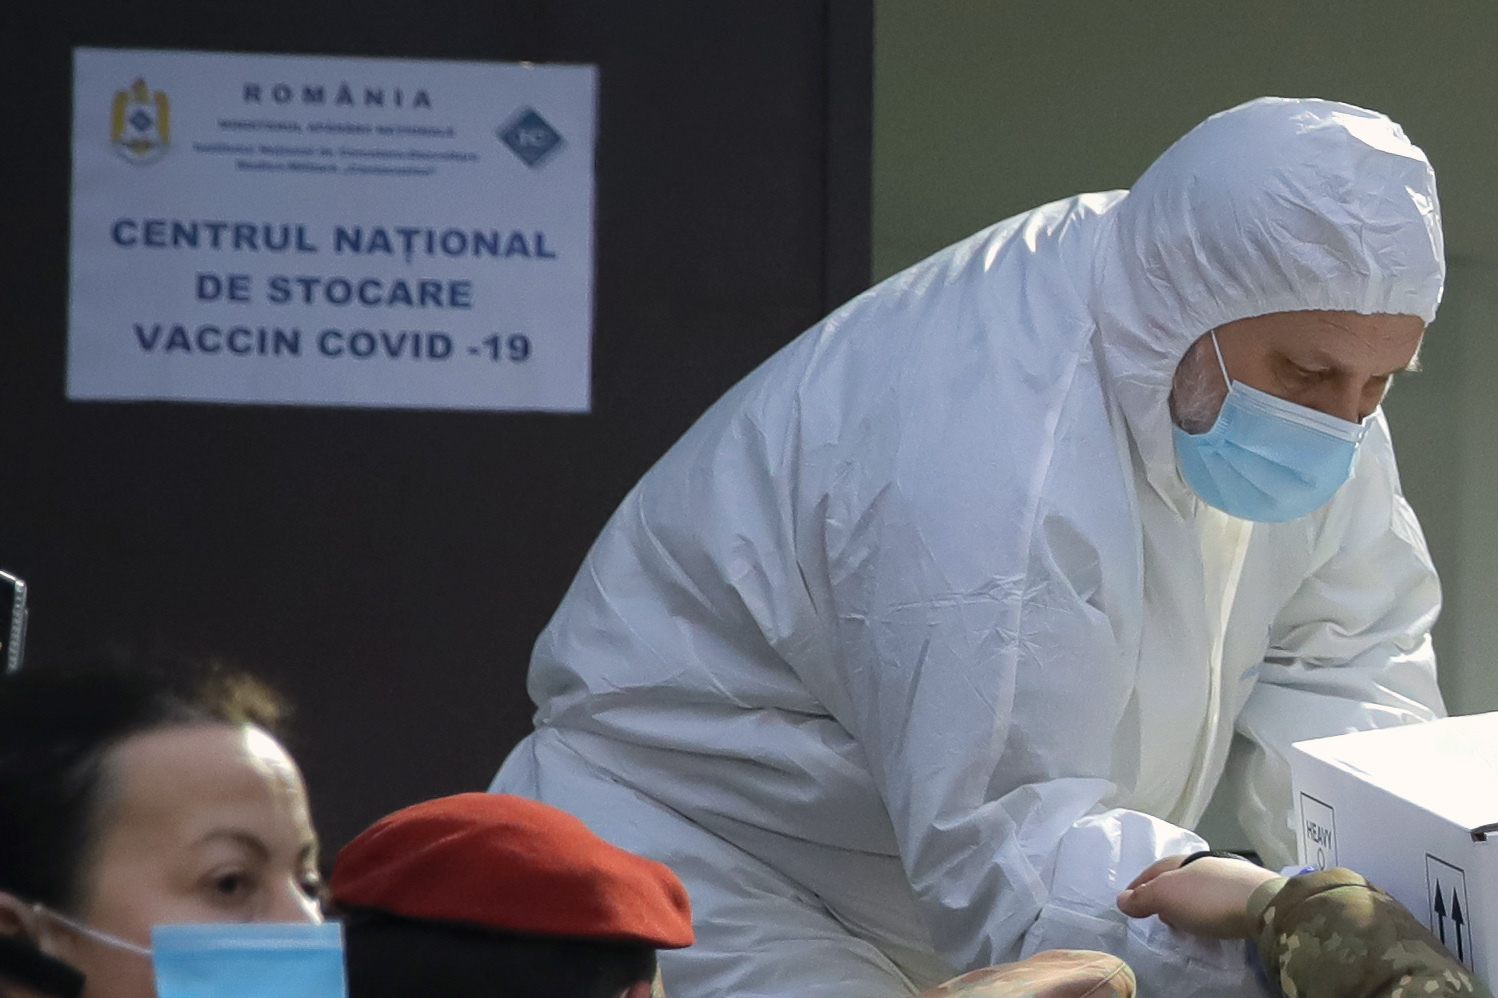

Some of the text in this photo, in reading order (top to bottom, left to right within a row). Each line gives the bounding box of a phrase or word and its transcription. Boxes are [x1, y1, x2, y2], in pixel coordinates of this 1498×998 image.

[242, 80, 432, 109] ROMÂNIA
[110, 218, 557, 264] CENTRUL NAȚIONAL
[195, 272, 474, 308] DE STOCARE
[133, 323, 532, 363] VACCIN COVID -19
[1305, 819, 1332, 850] HEAVY
